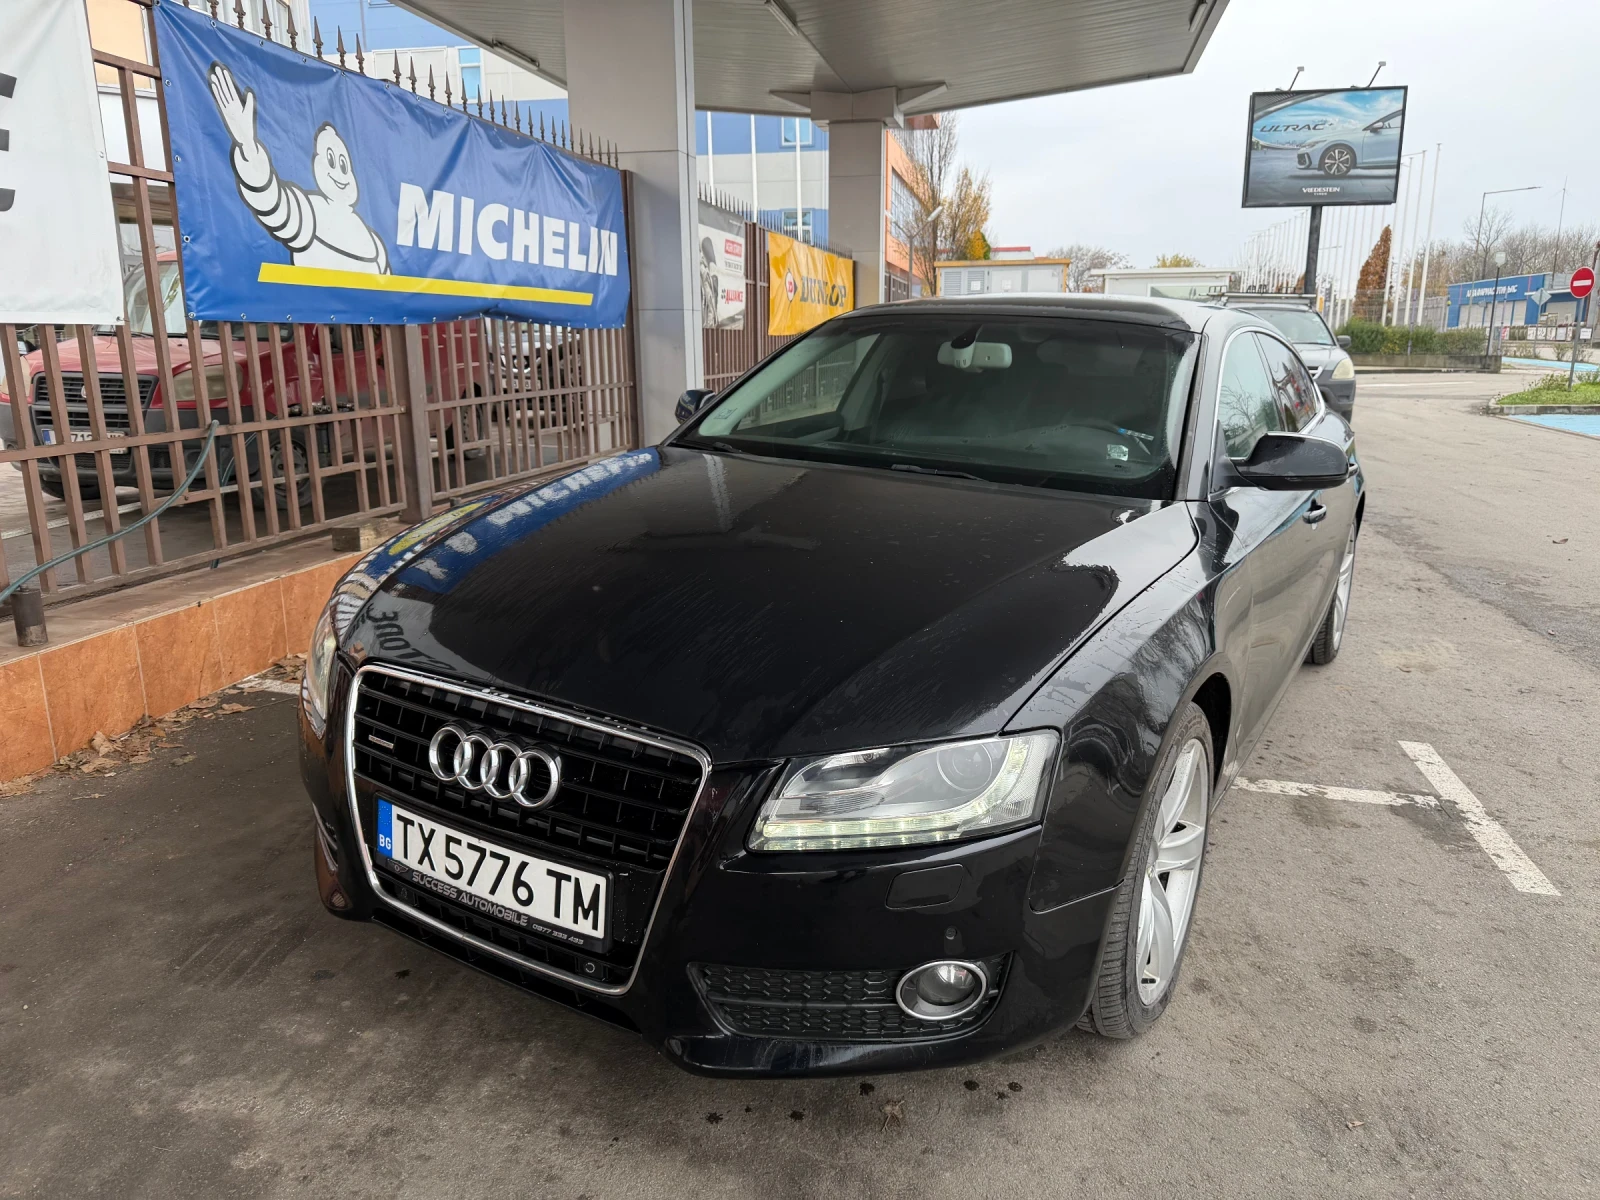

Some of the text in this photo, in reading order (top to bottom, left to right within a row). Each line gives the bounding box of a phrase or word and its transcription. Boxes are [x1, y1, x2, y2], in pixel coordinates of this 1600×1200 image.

[396, 182, 618, 276] MICHELIN
[801, 276, 847, 307] DUNLOP
[379, 833, 392, 850] BG
[396, 813, 600, 932] TX 5776 TM
[412, 871, 457, 899] SUCCESS
[459, 892, 528, 926] AUTOMOBILE
